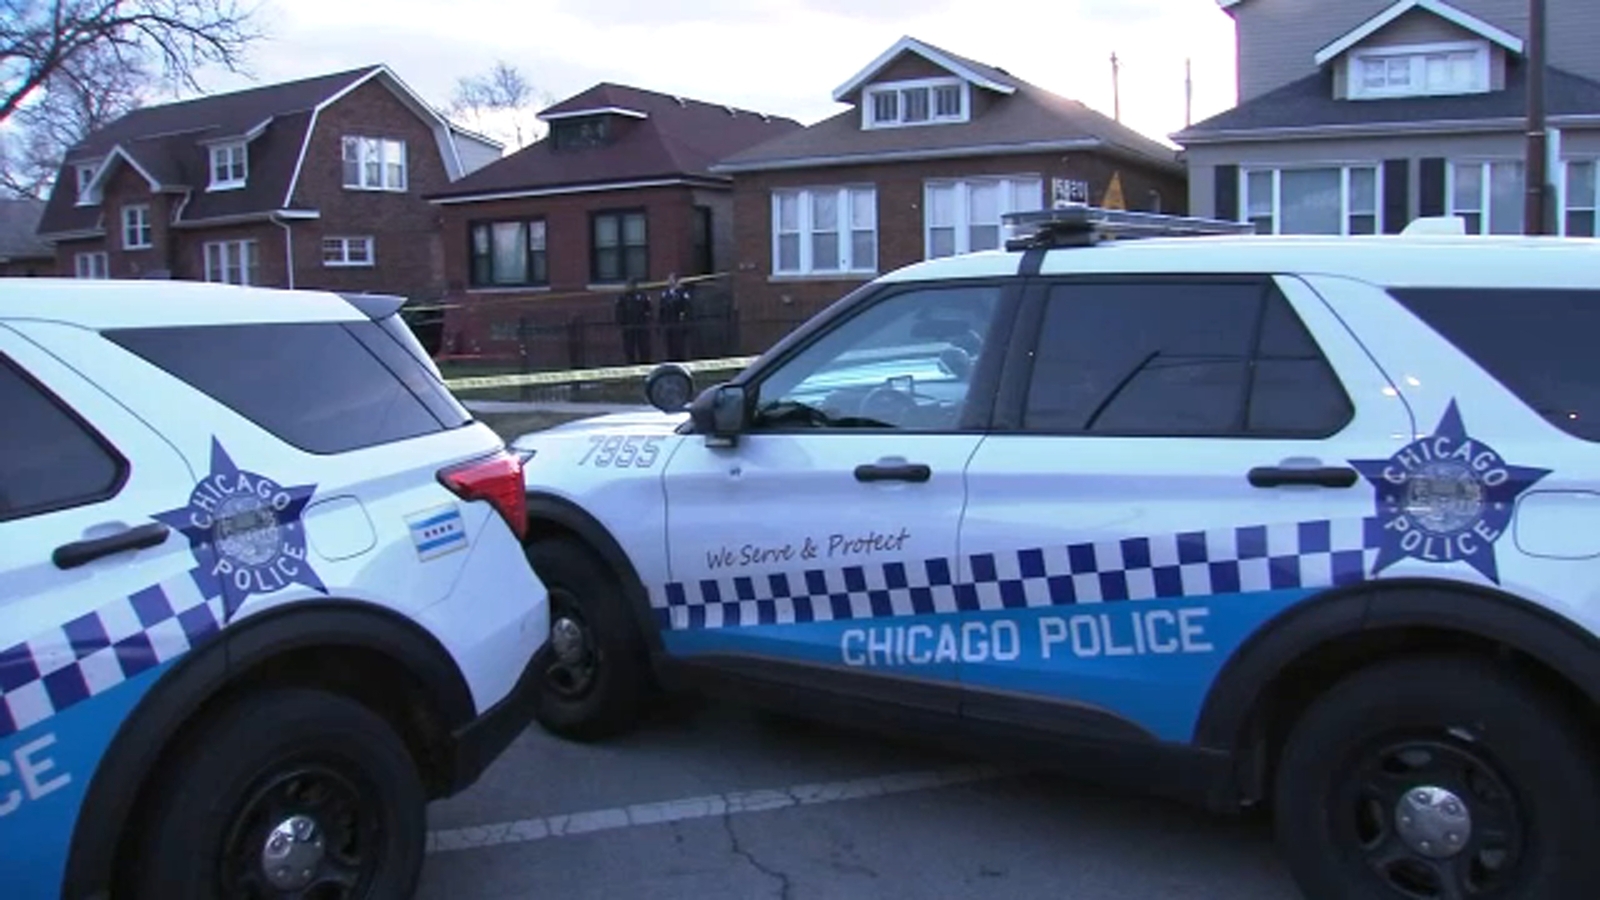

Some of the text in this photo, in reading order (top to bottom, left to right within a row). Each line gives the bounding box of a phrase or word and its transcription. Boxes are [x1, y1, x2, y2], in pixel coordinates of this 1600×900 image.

[577, 435, 667, 468] 7955
[1383, 437, 1508, 486] CHICAGO
[191, 473, 291, 530] CHICAGO
[706, 527, 911, 569] We Serve & Protect
[1384, 519, 1499, 560] POLICE
[211, 542, 305, 591] POLICE
[840, 607, 1214, 668] CHICAGO POLICE
